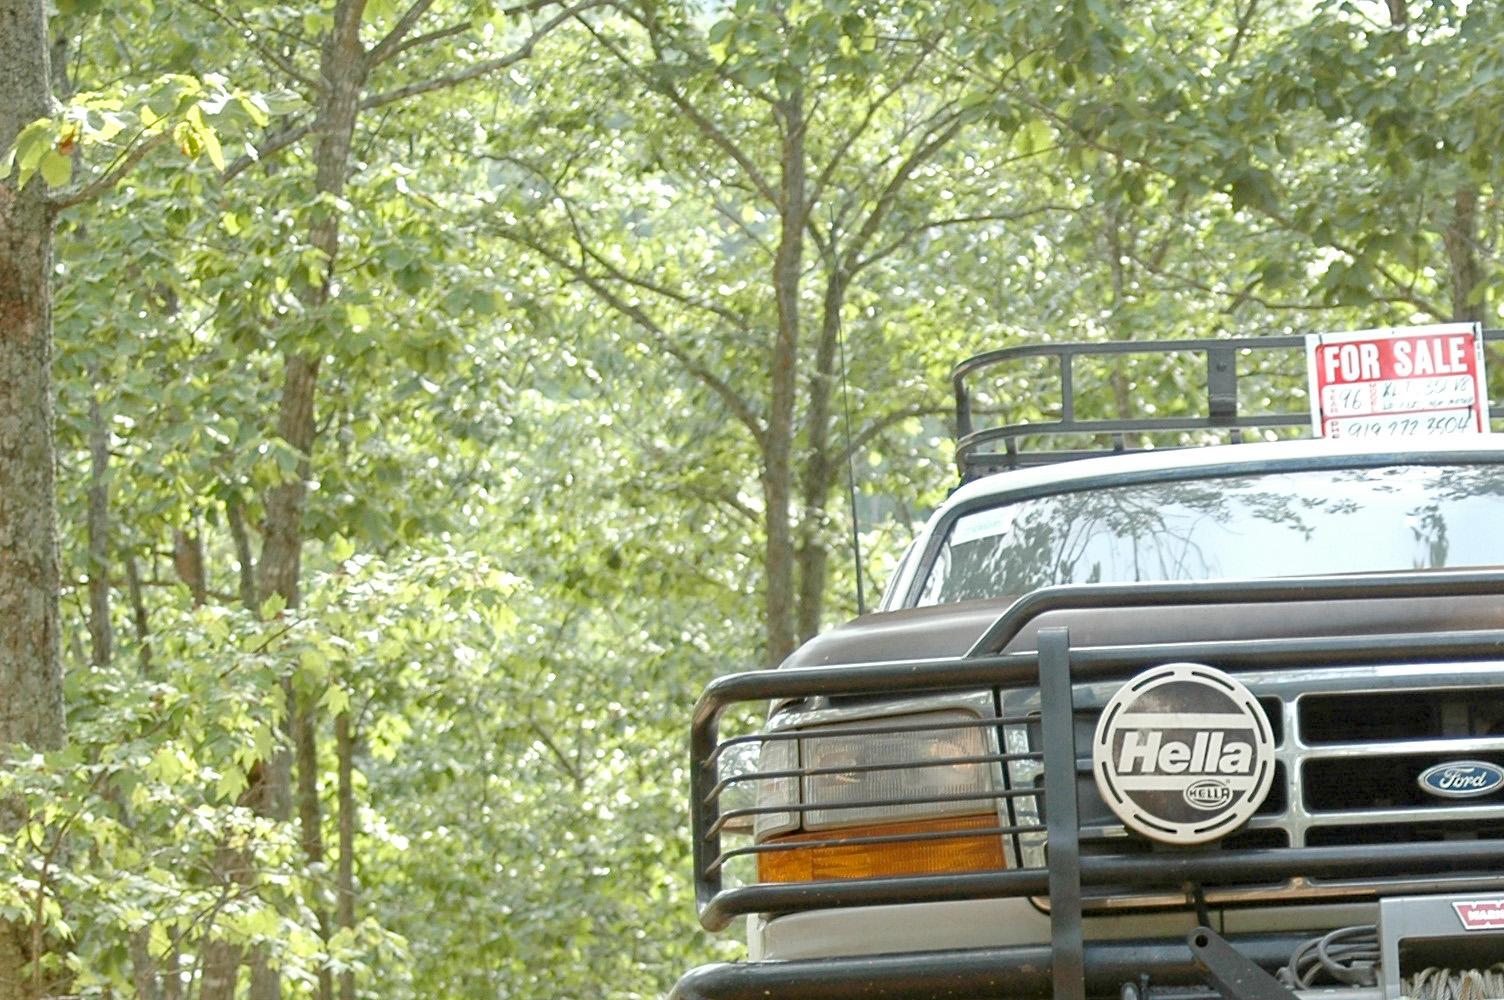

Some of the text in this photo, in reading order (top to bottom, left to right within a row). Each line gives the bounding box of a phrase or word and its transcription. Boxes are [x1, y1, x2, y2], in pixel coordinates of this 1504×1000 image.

[1324, 343, 1381, 383] FOR
[1393, 336, 1468, 377] SALE
[1118, 731, 1252, 774] Hella
[1189, 786, 1230, 800] HELLA
[1440, 766, 1487, 789] Ford
